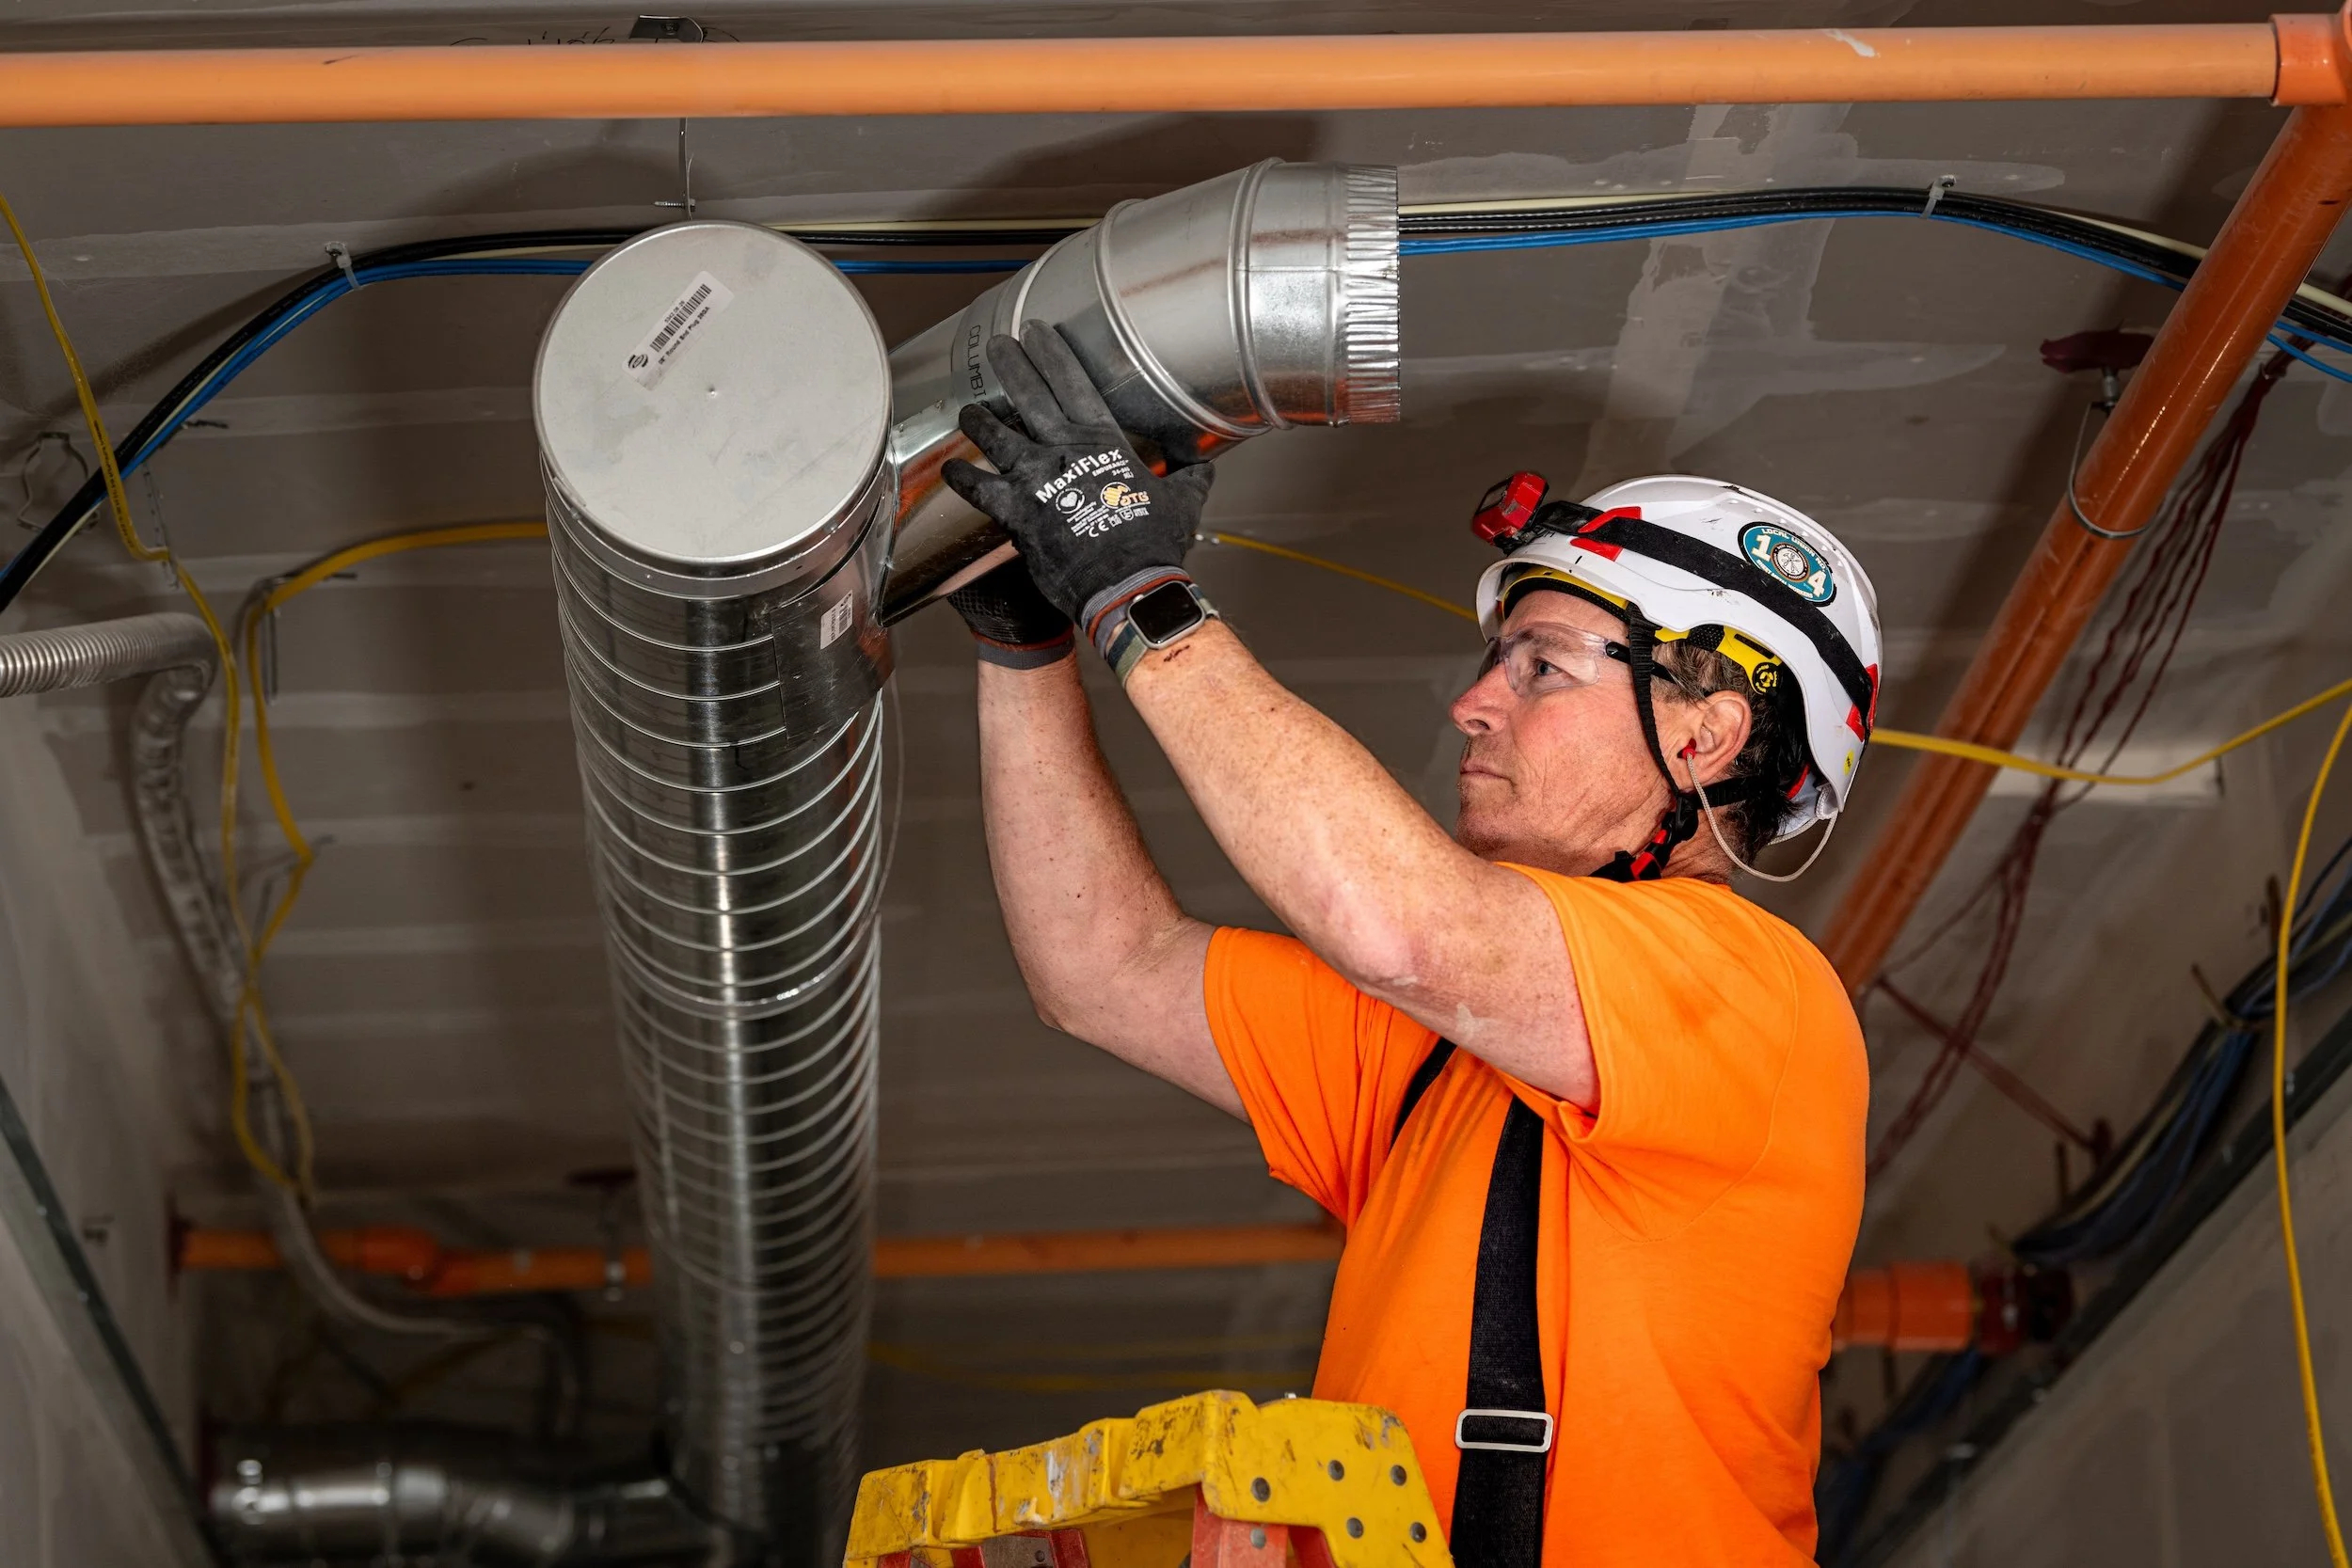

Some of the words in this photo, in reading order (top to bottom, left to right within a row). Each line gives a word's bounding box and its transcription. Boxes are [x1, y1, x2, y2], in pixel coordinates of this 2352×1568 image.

[1035, 449, 1123, 504] MaxiFlex
[1761, 529, 1789, 540] LOCAL
[1791, 537, 1816, 557] UNION
[1807, 569, 1827, 597] 4
